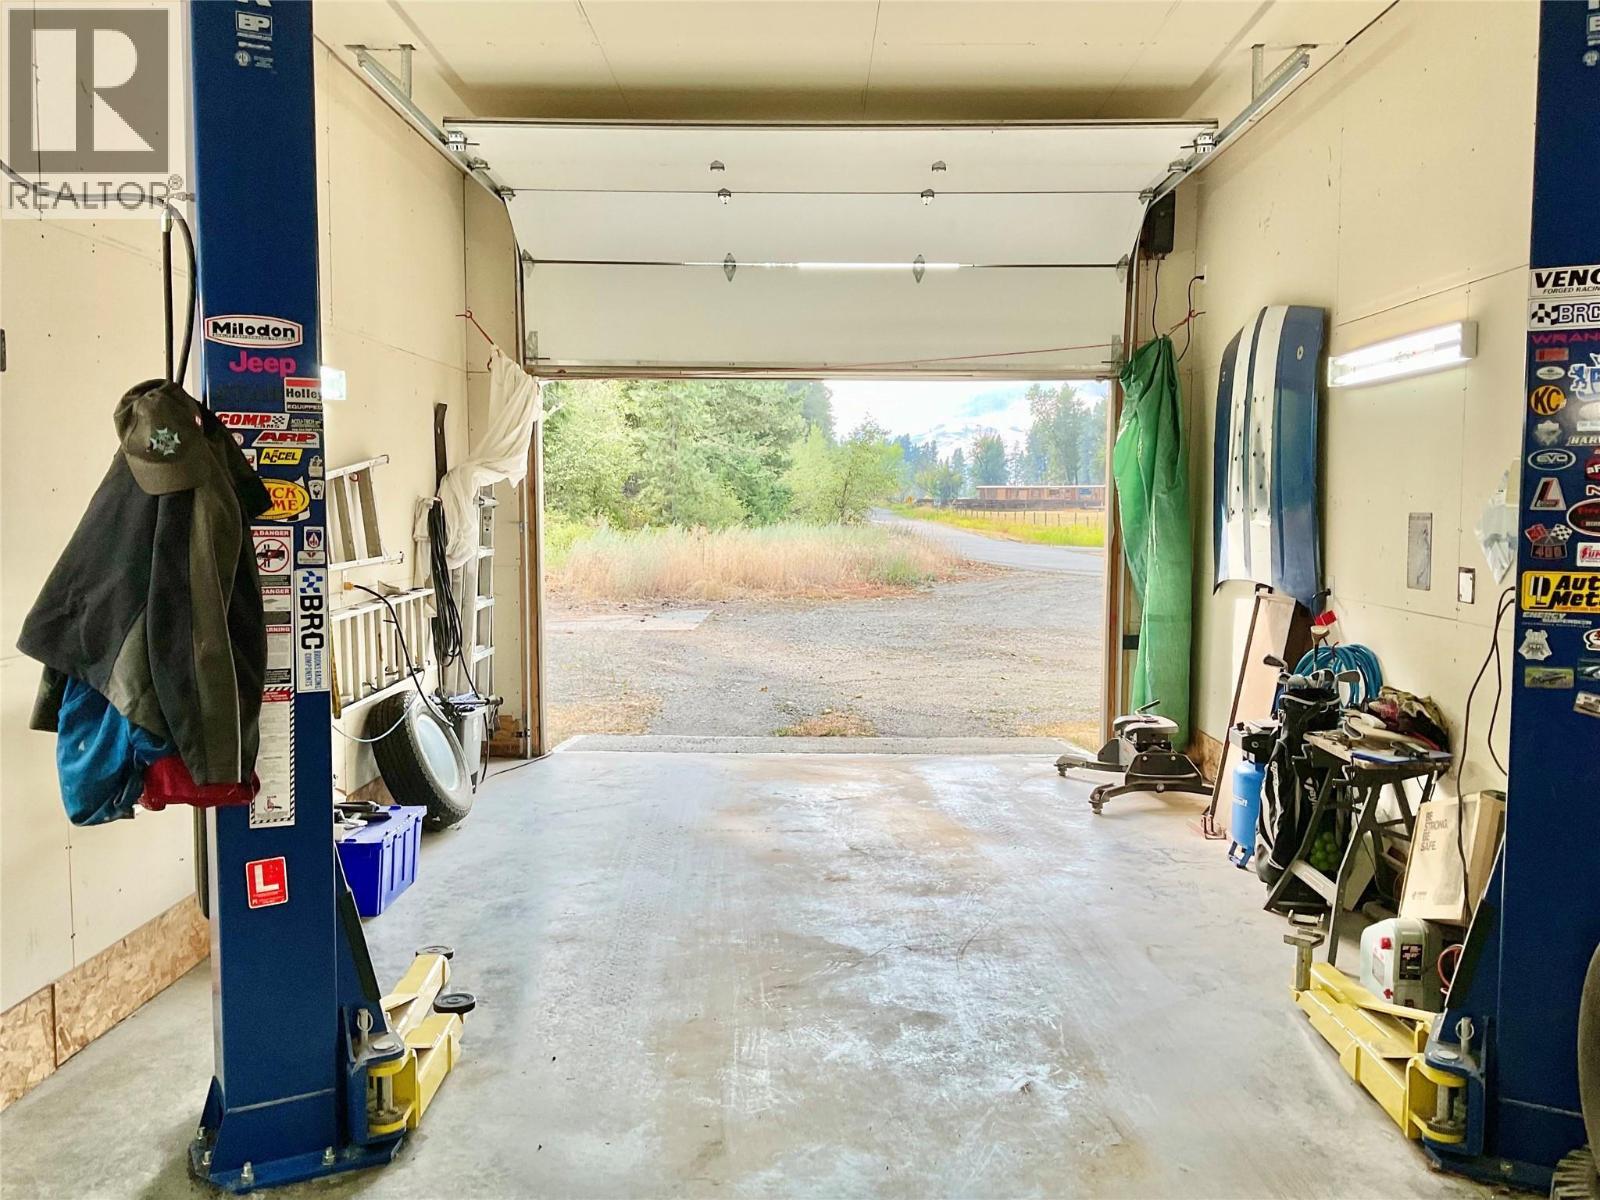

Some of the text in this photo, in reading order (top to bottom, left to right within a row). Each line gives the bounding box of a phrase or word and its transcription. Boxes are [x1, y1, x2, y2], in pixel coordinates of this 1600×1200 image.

[212, 321, 295, 337] Milodon
[229, 351, 297, 377] Jeep
[1534, 386, 1561, 413] KC
[217, 413, 272, 426] COMP
[258, 433, 316, 442] ARP
[263, 450, 297, 463] ACCEL
[272, 499, 298, 511] ME
[299, 595, 325, 650] BRC
[254, 864, 280, 893] L
